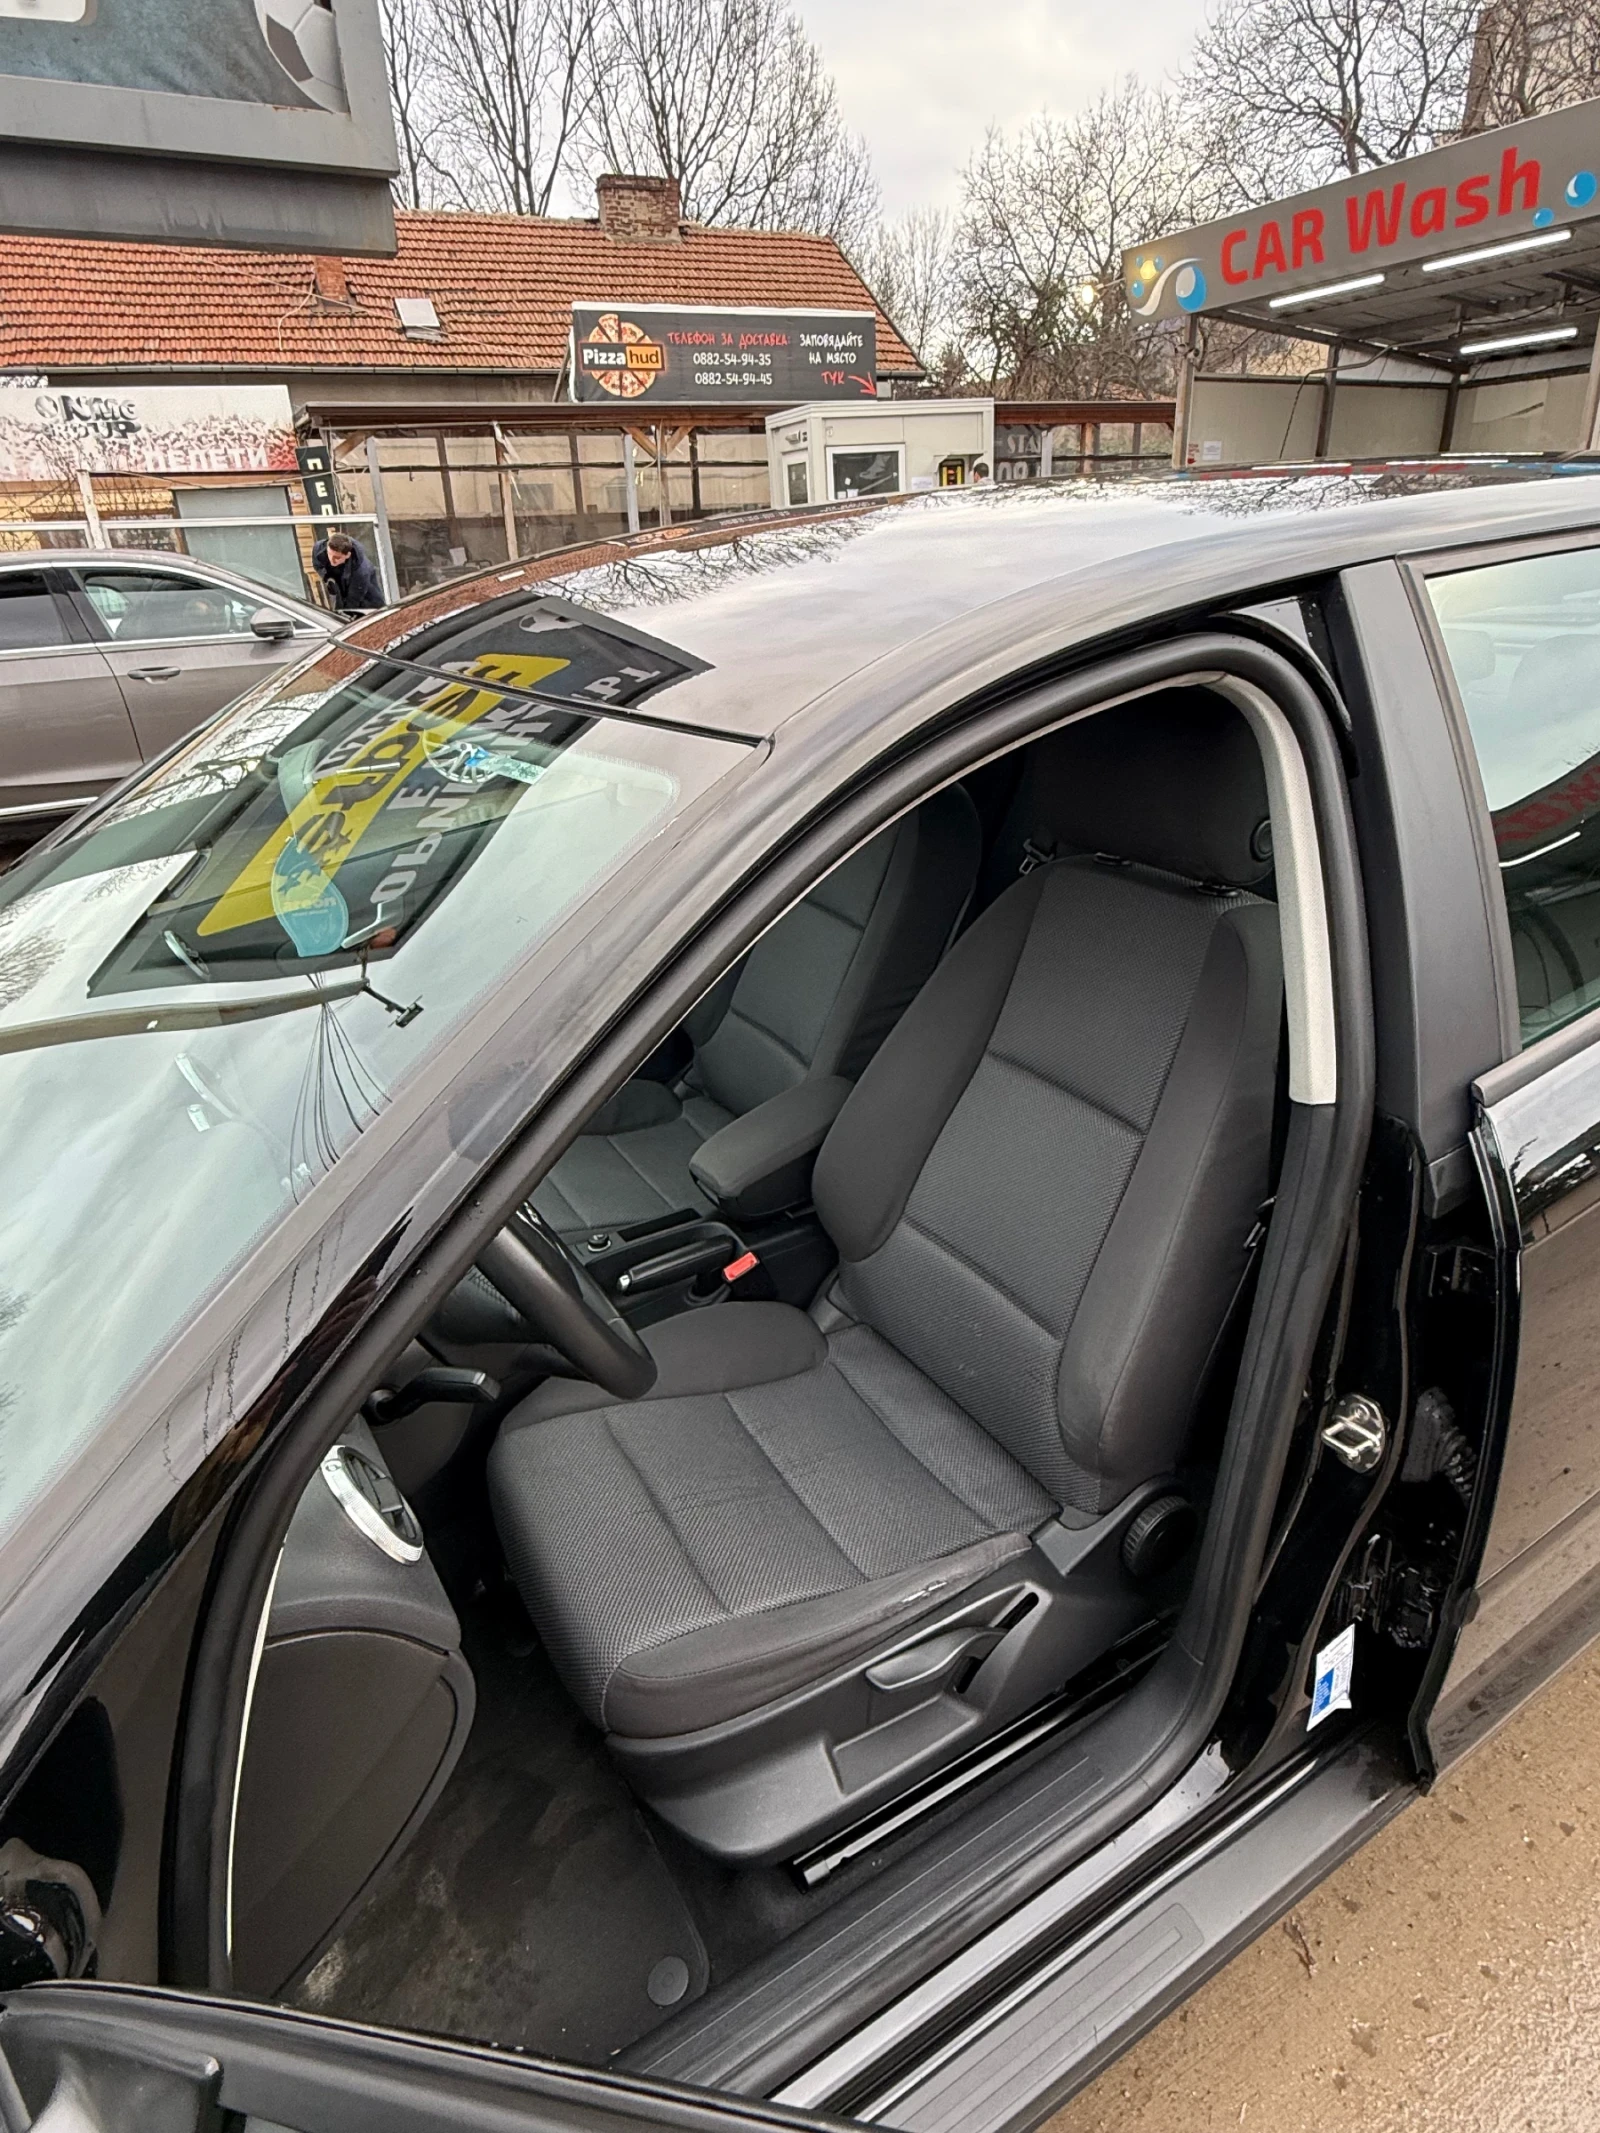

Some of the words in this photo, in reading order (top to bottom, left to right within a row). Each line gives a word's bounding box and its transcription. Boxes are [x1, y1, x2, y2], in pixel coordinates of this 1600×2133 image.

[1220, 208, 1326, 286] CAR
[1345, 146, 1542, 253] Wash
[667, 331, 715, 345] ТЕЛЕФОН
[720, 332, 734, 345] ЗА
[739, 333, 791, 350] ДОСТАВКА:
[799, 331, 864, 351] ЗАПОВЯДАЙТЕ
[582, 348, 627, 365] Pizza
[629, 350, 660, 364] hud
[692, 352, 772, 366] 0882-54-94-35
[808, 352, 822, 364] НА
[826, 352, 857, 365] МЯСТО
[694, 372, 773, 386] 0882-54-94-45
[821, 370, 845, 386] ТУК
